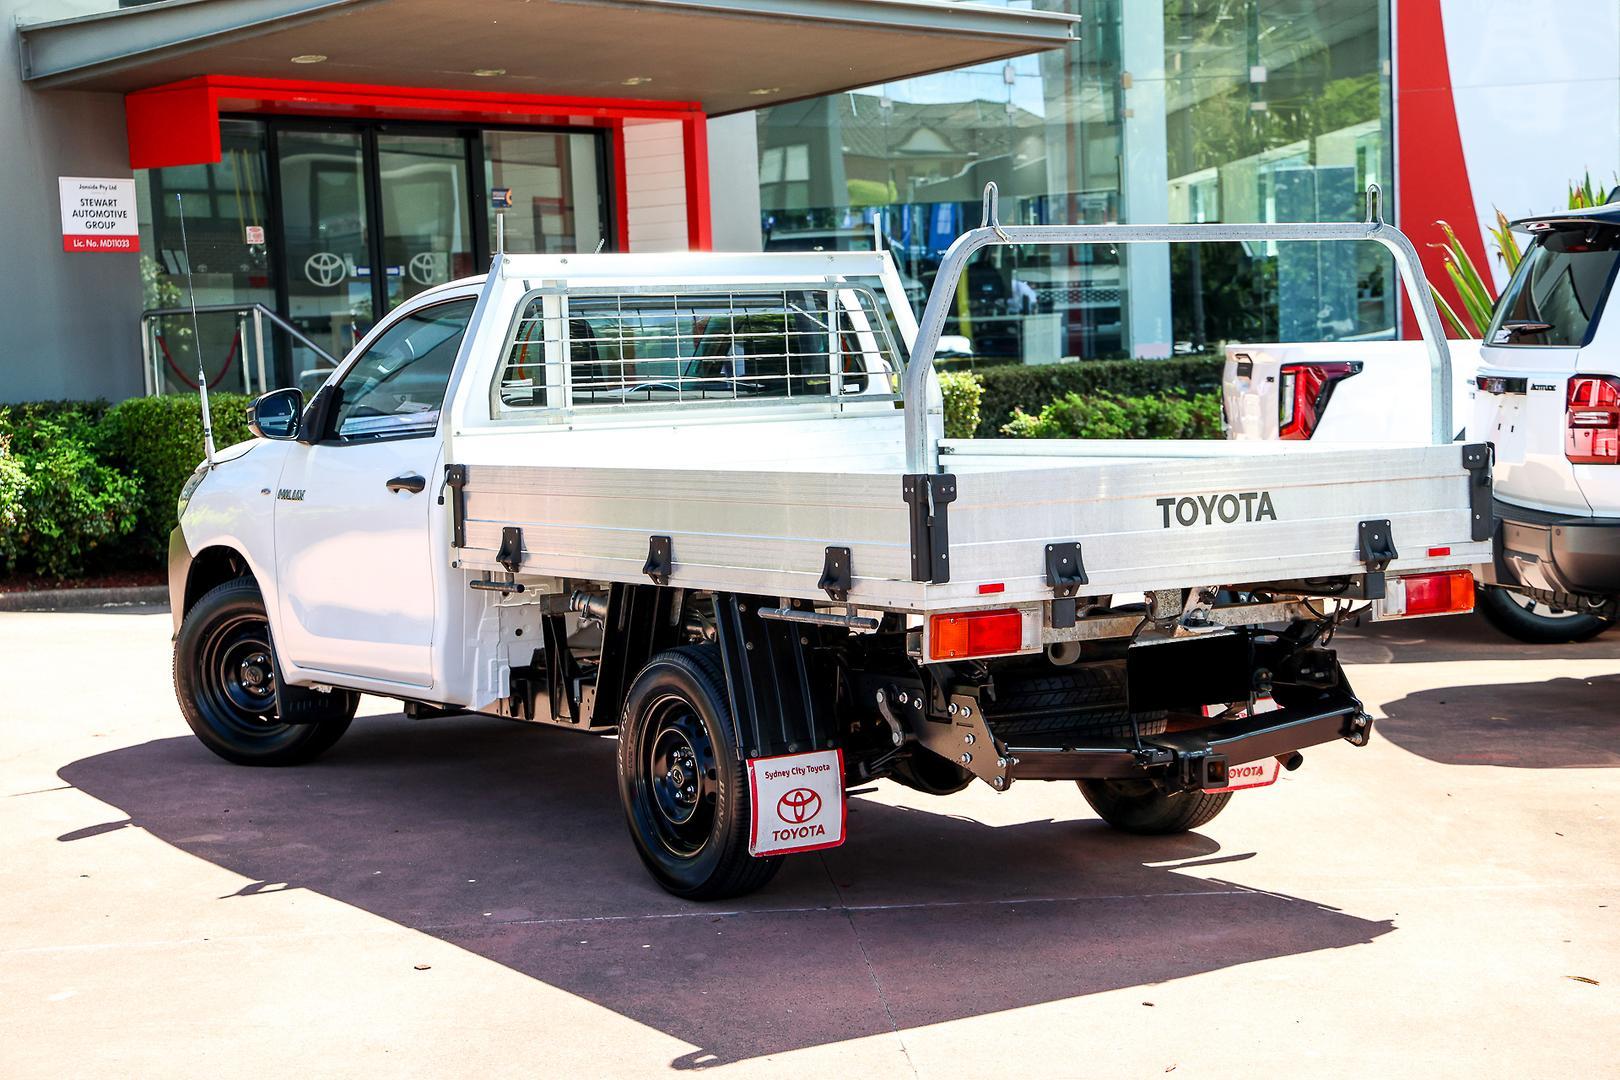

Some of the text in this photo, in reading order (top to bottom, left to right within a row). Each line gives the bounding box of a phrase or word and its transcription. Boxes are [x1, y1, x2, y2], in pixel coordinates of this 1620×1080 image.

[80, 199, 118, 207] STEWART
[72, 210, 128, 218] AUTOMOTIVE
[85, 221, 116, 230] GROUP
[73, 239, 85, 248] Lic.
[86, 239, 99, 248] No.
[1156, 491, 1277, 528] TOYOTA
[764, 764, 830, 780] Sydney City Toyota
[1229, 766, 1264, 779] OYOTA
[772, 824, 826, 842] TOYOTA
